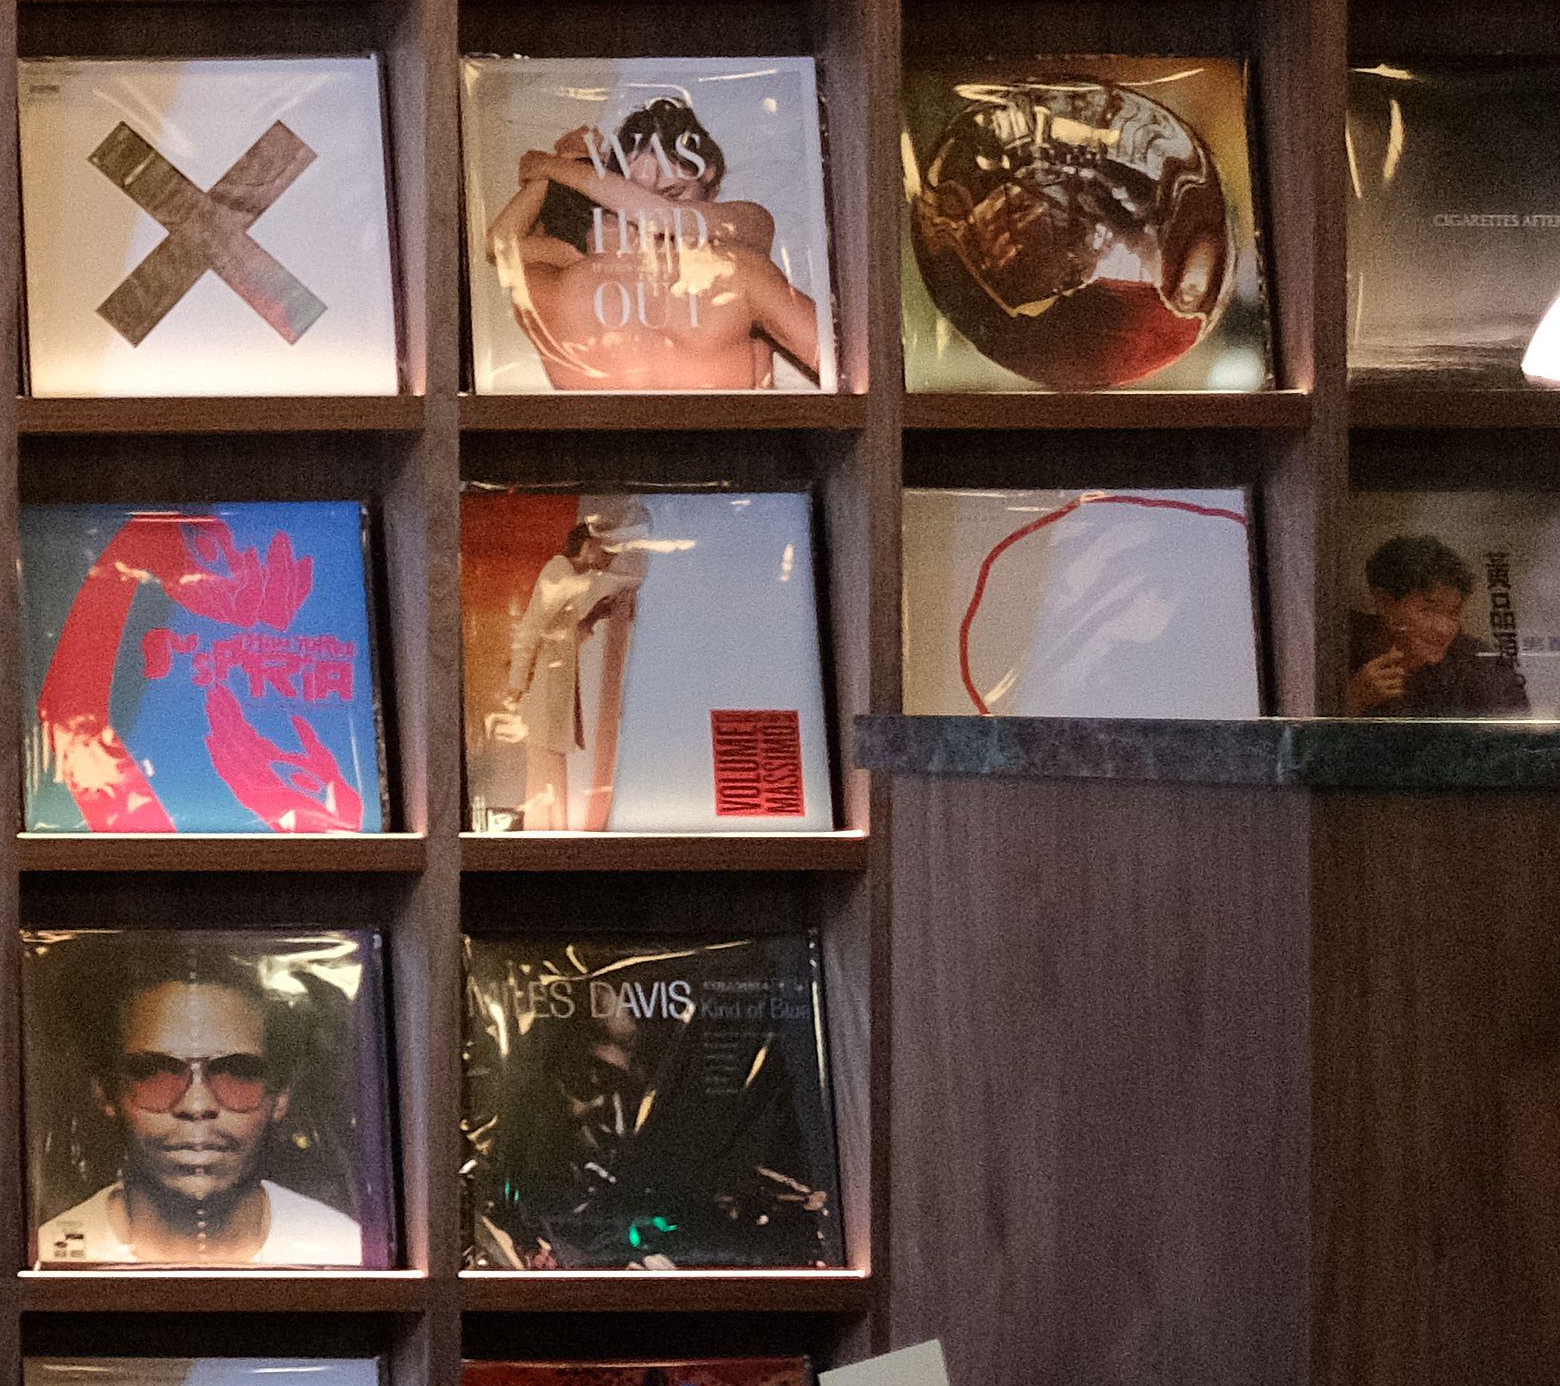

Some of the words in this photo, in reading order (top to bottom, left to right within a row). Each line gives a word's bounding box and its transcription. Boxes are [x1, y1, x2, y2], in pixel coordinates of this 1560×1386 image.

[585, 132, 708, 183] WAS
[1433, 214, 1520, 229] CIGARETTES
[714, 725, 761, 813] VOLUME
[763, 721, 801, 815] MASSIMO
[590, 980, 694, 1020] DAVIS
[701, 999, 741, 1020] Kind
[745, 999, 765, 1020] of
[769, 999, 810, 1020] Blue
